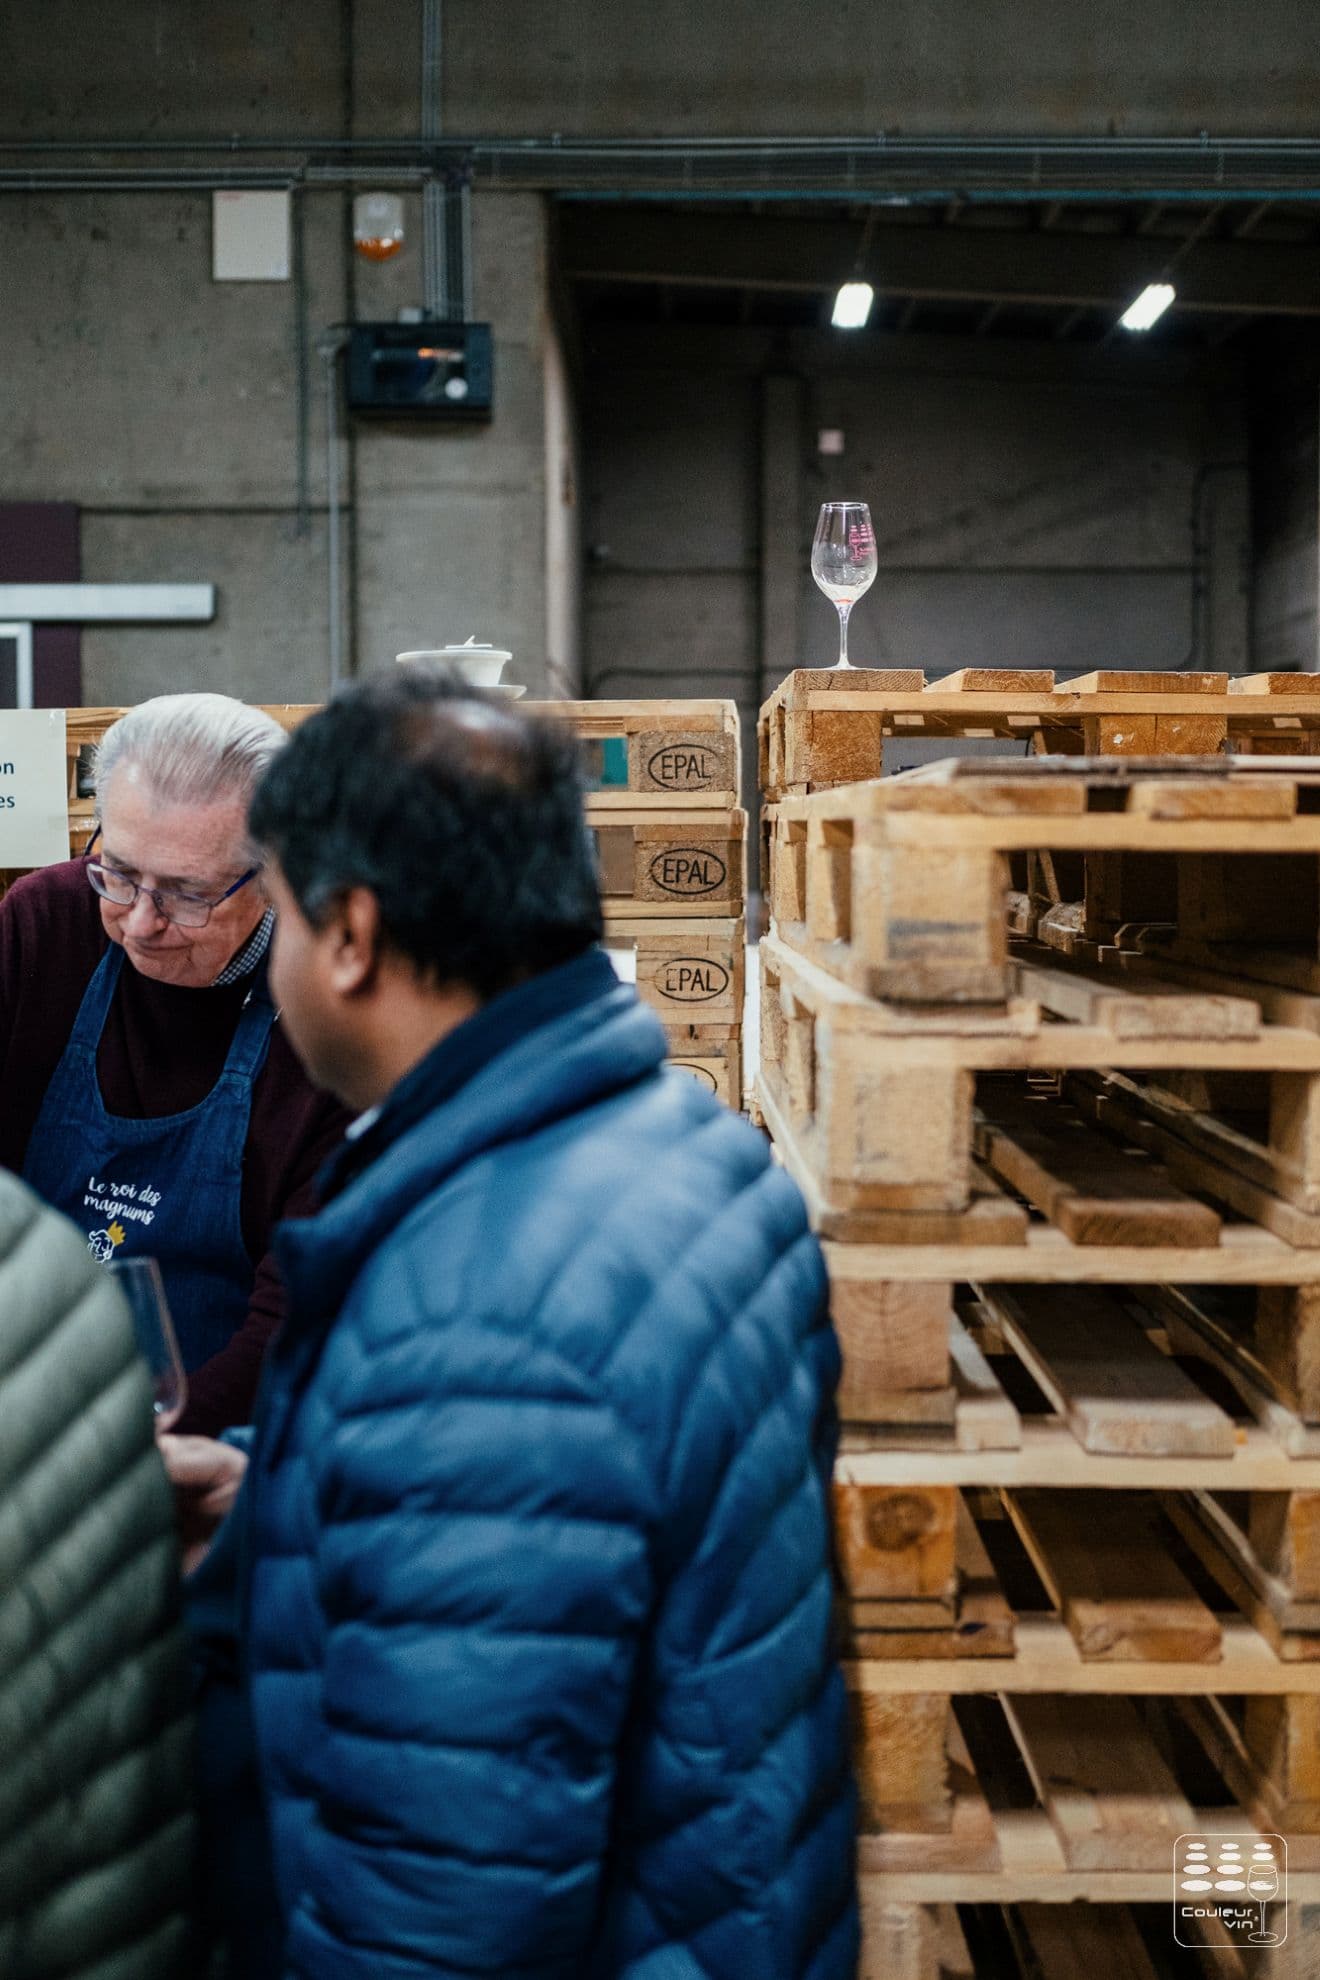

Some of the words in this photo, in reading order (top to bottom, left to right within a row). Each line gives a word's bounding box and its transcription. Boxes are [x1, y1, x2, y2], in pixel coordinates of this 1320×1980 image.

[0, 762, 15, 775] n
[661, 754, 712, 780] EPAL
[662, 858, 715, 886] EPAL
[666, 967, 718, 992] EPAL
[88, 1176, 107, 1194] Le
[110, 1182, 137, 1199] roi
[138, 1184, 162, 1207] des
[83, 1194, 155, 1226] magnums
